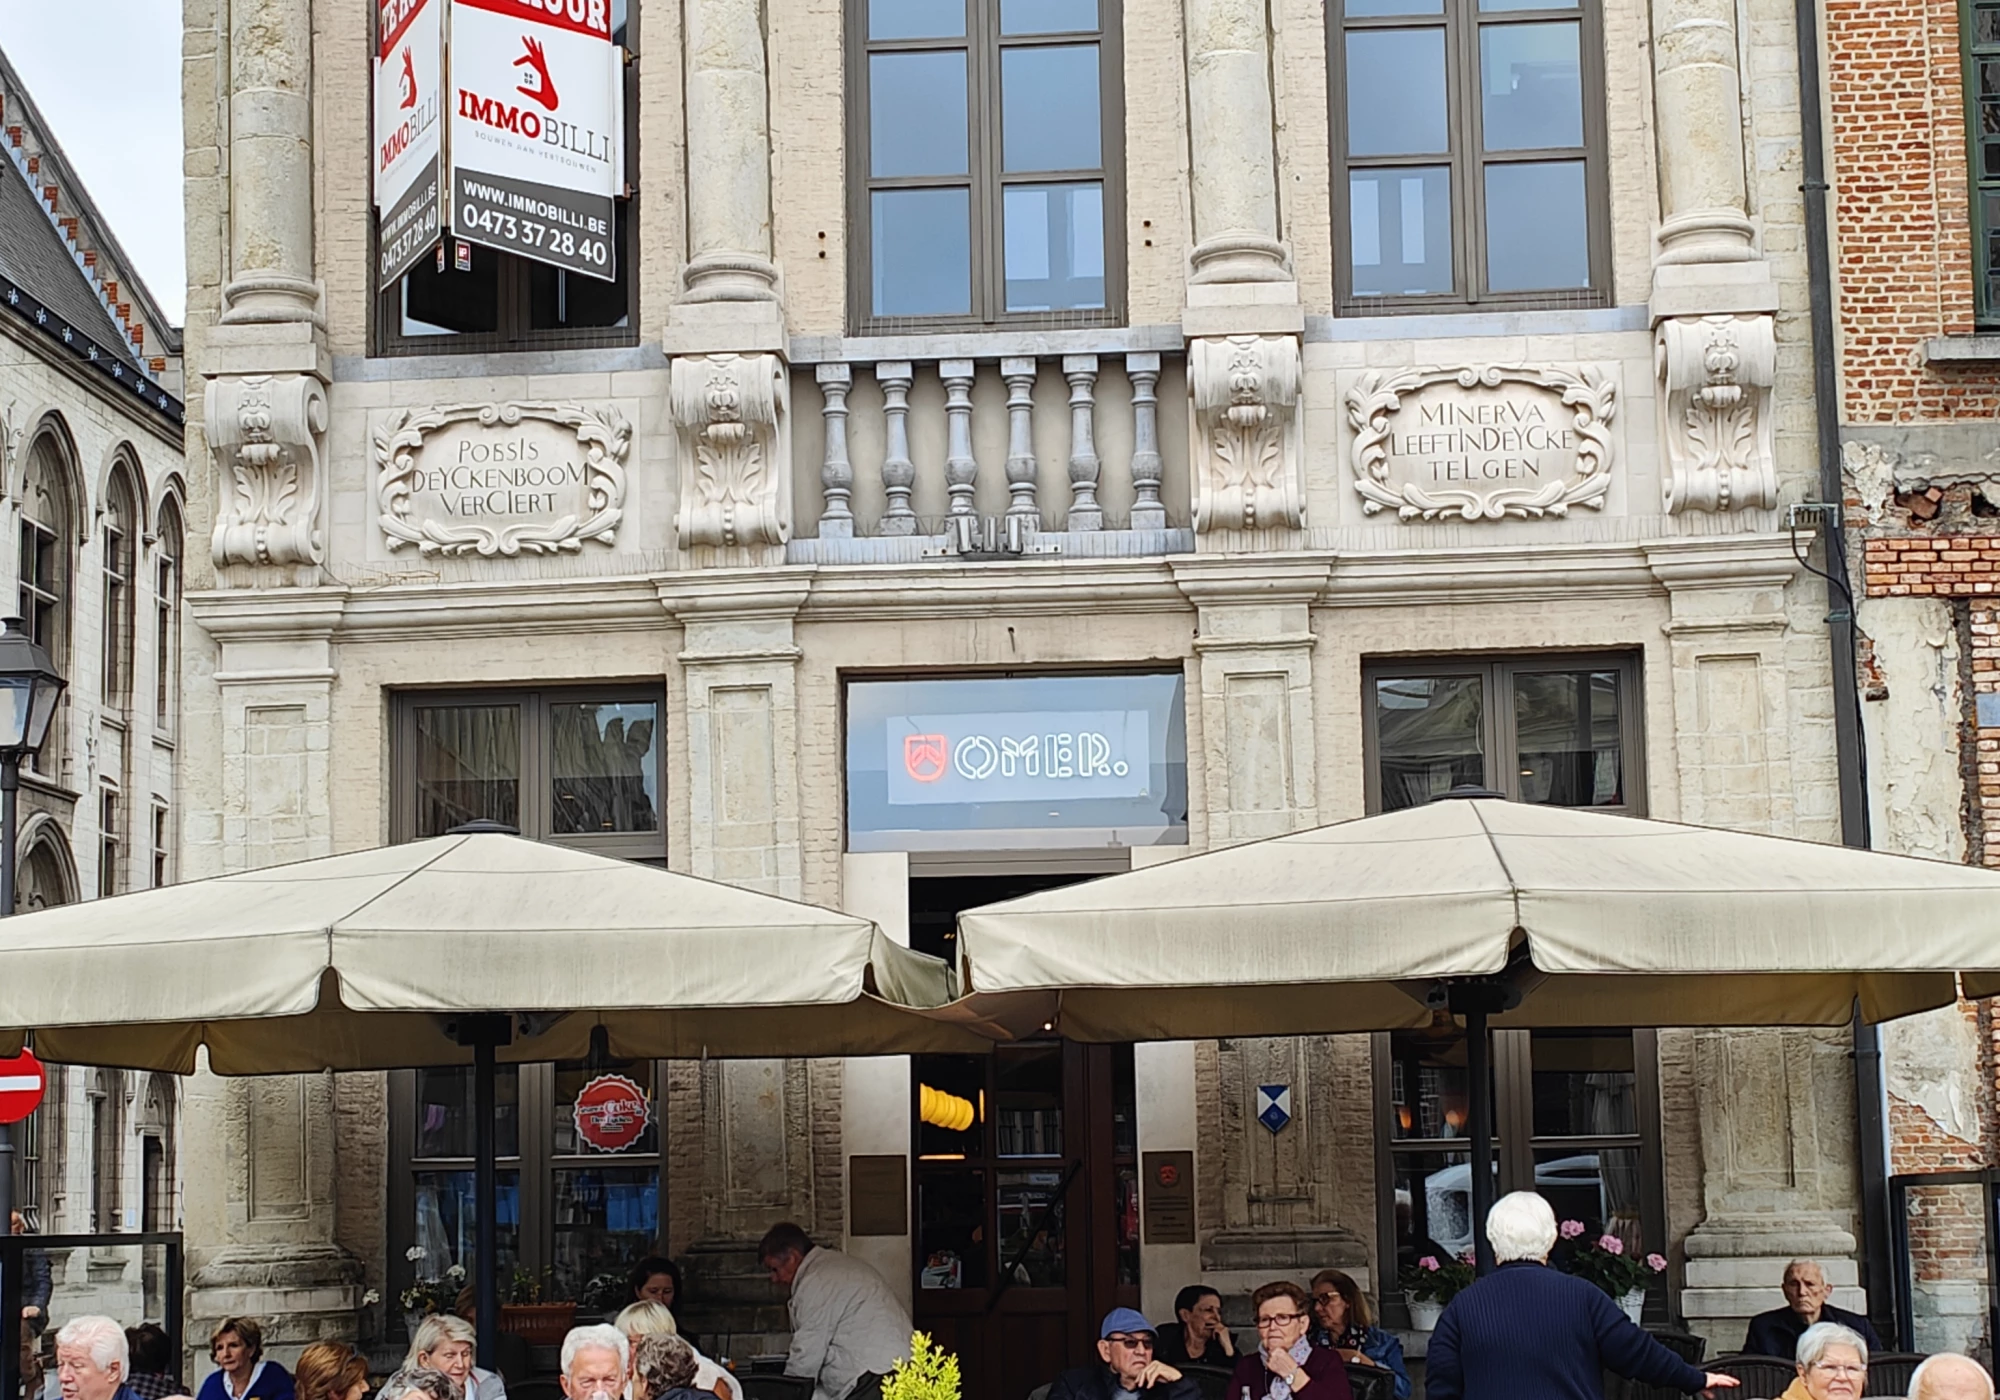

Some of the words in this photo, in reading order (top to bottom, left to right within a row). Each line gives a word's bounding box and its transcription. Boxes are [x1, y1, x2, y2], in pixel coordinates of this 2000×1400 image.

[517, 0, 607, 33] UR
[380, 89, 437, 174] IMMOBILLI
[458, 88, 610, 163] IMMOBILLI
[463, 179, 608, 236] WWW.IMMOBILLI.BE
[463, 203, 517, 240] 0473
[521, 219, 546, 247] 37
[549, 229, 575, 257] 28
[579, 238, 607, 266] 40
[381, 238, 402, 275] 0473
[402, 227, 413, 257] 37
[413, 217, 424, 247] 28
[424, 205, 437, 234] 40
[1420, 401, 1546, 427] MINERVA
[1428, 455, 1541, 481] TELGEN
[440, 490, 558, 516] VERCIERT
